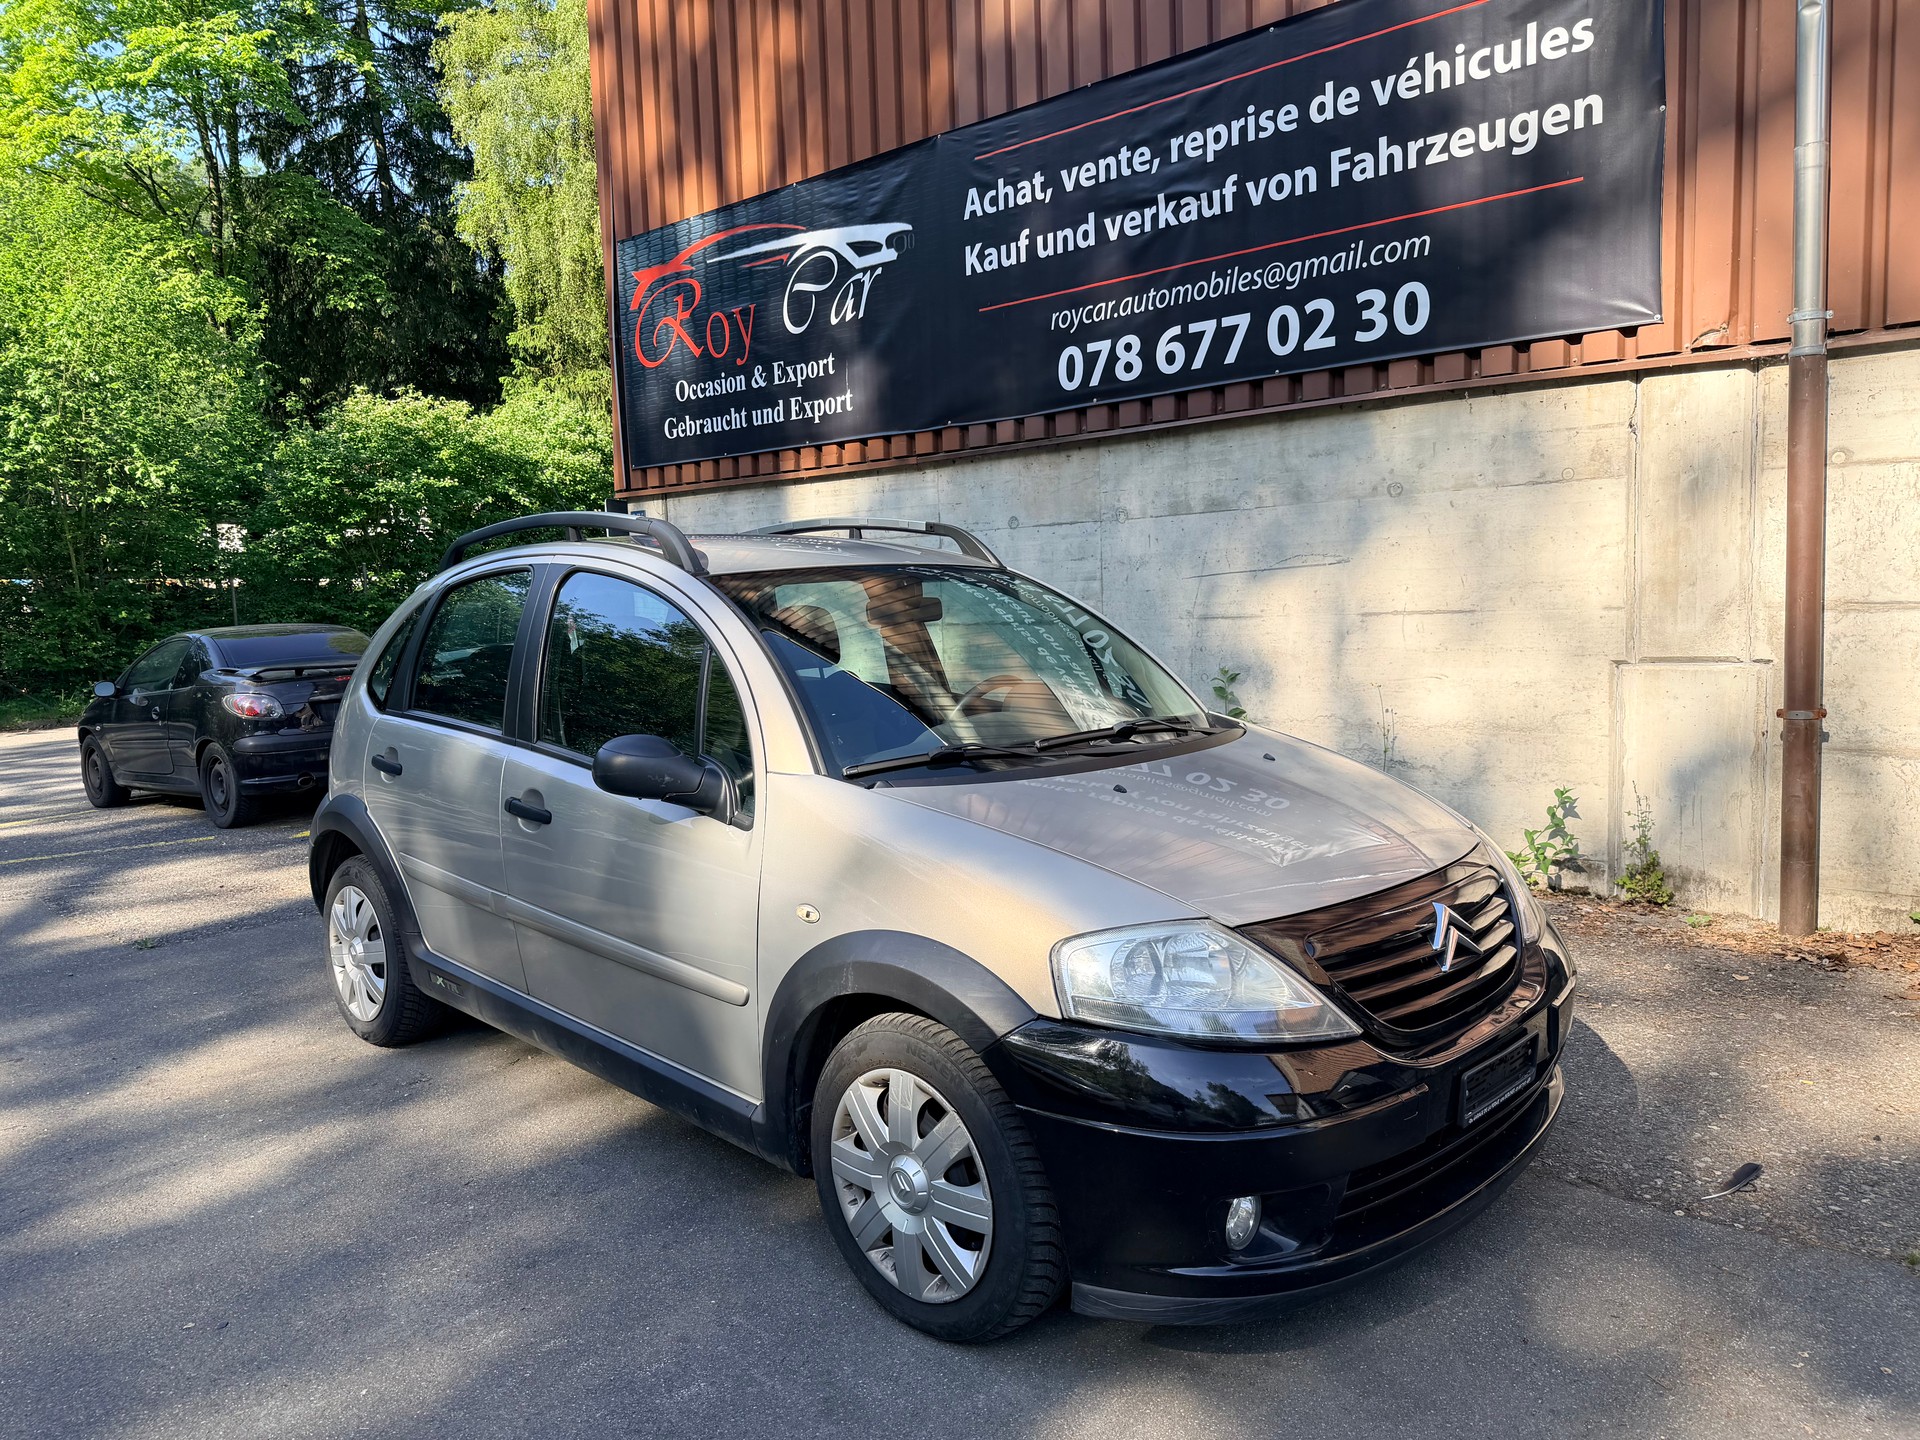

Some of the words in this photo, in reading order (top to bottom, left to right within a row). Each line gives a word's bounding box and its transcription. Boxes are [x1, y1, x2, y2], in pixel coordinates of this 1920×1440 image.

[963, 170, 1054, 221] Achat,
[1059, 145, 1161, 194] vente,
[1170, 103, 1300, 165] reprise
[1308, 80, 1361, 125] de
[1370, 16, 1596, 108] véhicules
[964, 226, 1031, 277] Kauf
[1036, 211, 1097, 259] und
[1103, 176, 1238, 243] verkauf
[1245, 165, 1317, 208] von
[1330, 94, 1604, 189] Fahrzeugen
[634, 277, 756, 369] Roy
[782, 250, 883, 335] Car
[1050, 232, 1431, 334] roycar.automobiles@gmail.com
[1057, 334, 1143, 391] 078
[1155, 312, 1252, 375] 677
[1266, 304, 1337, 356] 02
[1354, 281, 1431, 343] 30
[664, 407, 748, 440] Gebraucht
[751, 402, 785, 427] und
[789, 389, 854, 424] Export
[675, 371, 747, 402] Occasion
[751, 364, 767, 389] &
[771, 352, 836, 388] Export
